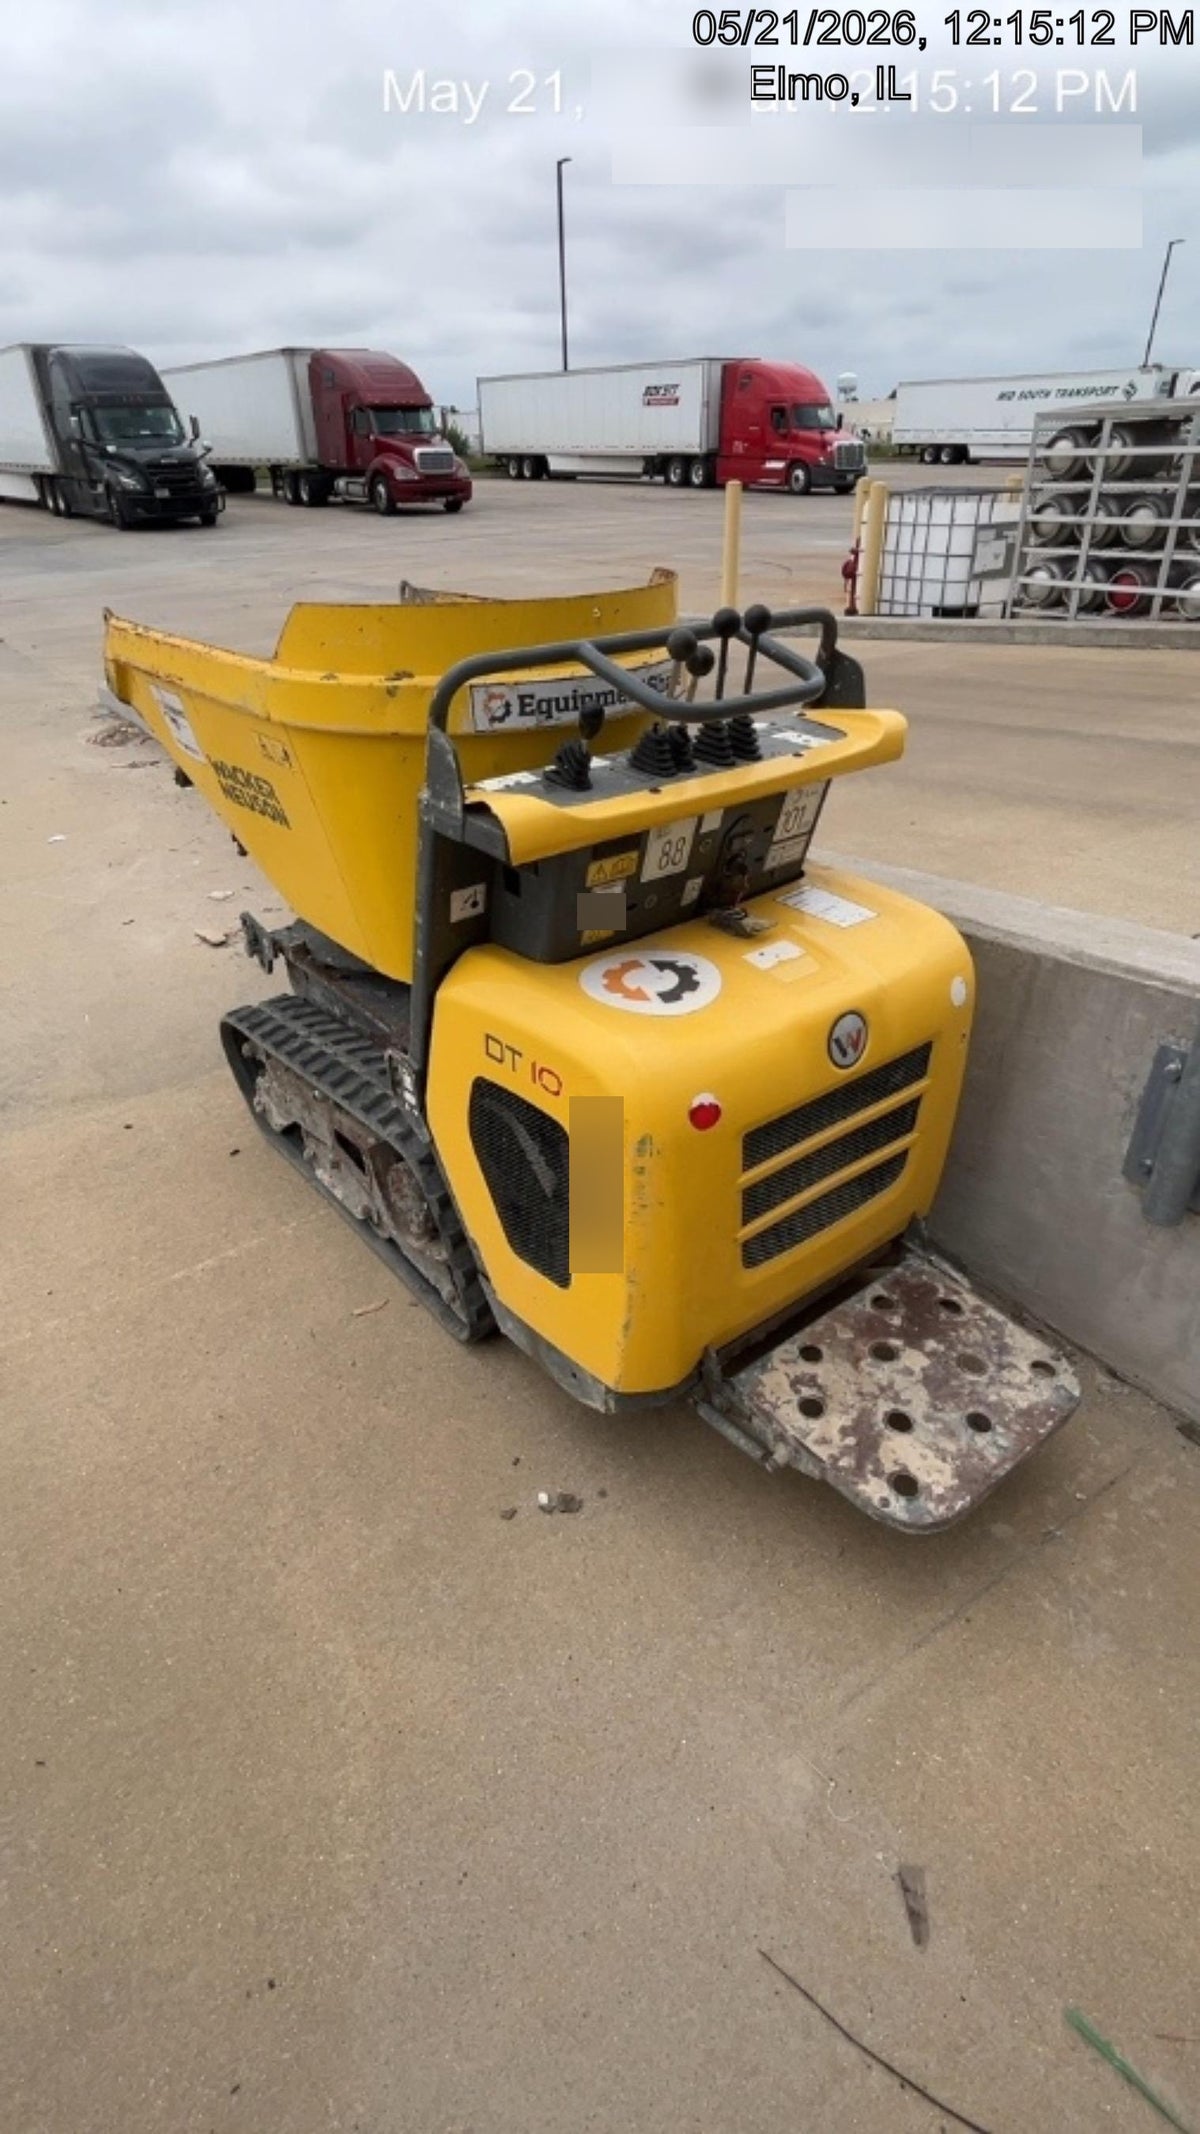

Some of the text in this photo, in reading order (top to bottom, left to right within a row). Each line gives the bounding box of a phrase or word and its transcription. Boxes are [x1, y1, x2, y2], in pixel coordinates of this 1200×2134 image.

[1017, 388, 1050, 400] SOUTH
[1054, 386, 1120, 398] TRANSPORT
[211, 761, 280, 805] WACKER
[218, 780, 292, 830] NEUSON
[658, 836, 686, 870] 88
[485, 1034, 562, 1096] DT 10
